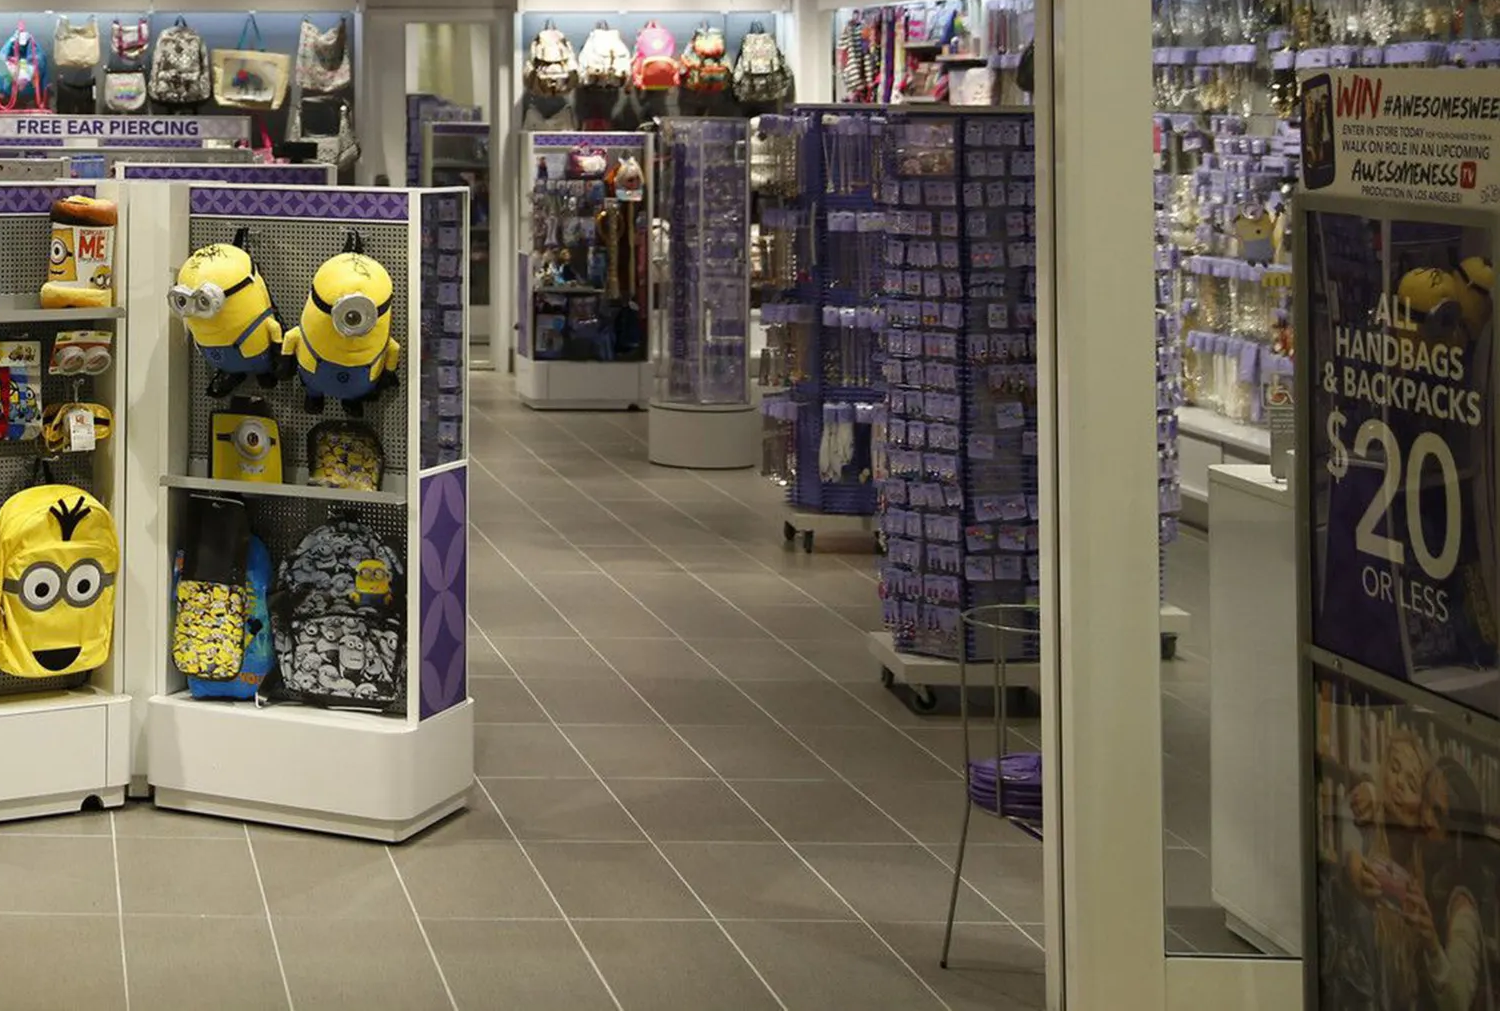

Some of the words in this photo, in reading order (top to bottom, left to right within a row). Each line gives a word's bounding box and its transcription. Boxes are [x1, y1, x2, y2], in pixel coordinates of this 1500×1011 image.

[1336, 74, 1382, 120] WIN
[16, 119, 62, 135] FREE
[67, 120, 104, 135] EAR
[109, 120, 199, 136] PIERCING
[1342, 124, 1365, 136] ENTER
[1366, 125, 1374, 136] IN
[1375, 126, 1399, 137] STORE
[1399, 127, 1425, 138] TODAY
[1342, 140, 1367, 152] WALK
[1368, 141, 1384, 154] ON
[1385, 142, 1407, 155] ROLE
[1409, 143, 1419, 156] IN
[1419, 144, 1435, 157] AN
[1435, 145, 1490, 160] UPCOMING
[1352, 159, 1458, 187] AWESOMENESS
[1361, 185, 1404, 199] PRODUCTION
[1406, 188, 1413, 199] IN
[1414, 189, 1427, 200] LOS
[79, 235, 105, 259] ME
[1374, 292, 1417, 331] ALL
[1335, 325, 1464, 381] HANDBAGS
[1323, 361, 1338, 394] &
[1343, 365, 1482, 426] BACKPACKS
[1326, 406, 1461, 580] $20
[1362, 566, 1394, 604] OR
[1399, 573, 1449, 623] LESS
